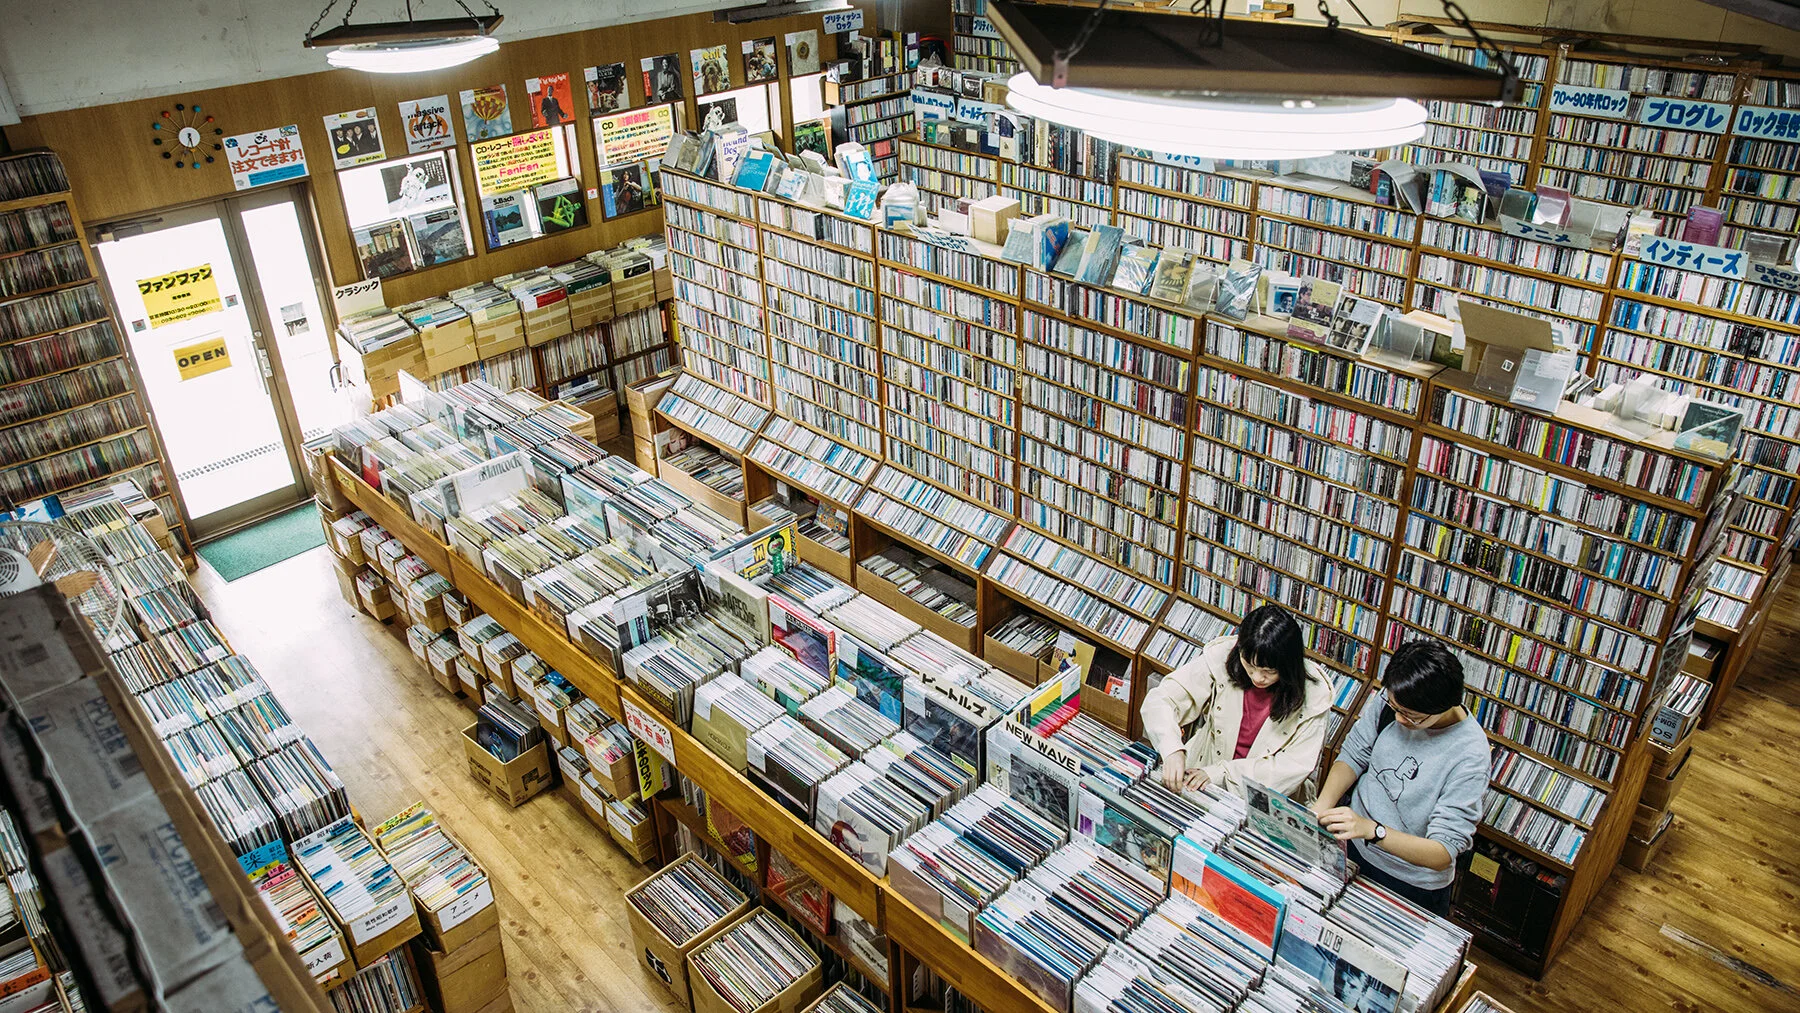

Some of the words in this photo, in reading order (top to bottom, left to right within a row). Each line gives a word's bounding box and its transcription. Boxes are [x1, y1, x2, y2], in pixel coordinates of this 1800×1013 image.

[825, 13, 861, 24] ブリティッシュ
[836, 21, 852, 30] ロック
[974, 20, 996, 32] ブリティッ
[413, 120, 442, 131] attack
[602, 121, 613, 130] CD
[1648, 102, 1723, 128] プログレ
[238, 137, 290, 158] レコード針
[231, 149, 304, 175] 注文できます!
[499, 162, 539, 177] FanFan
[1516, 222, 1571, 243] アニメ
[1646, 239, 1742, 275] インディーズ
[138, 268, 212, 295] ファンファン
[336, 281, 379, 299] クラシック
[178, 347, 226, 368] OPEN
[922, 673, 987, 718] ビートルズ
[1006, 721, 1033, 745] NEW
[1038, 740, 1077, 771] WAVE
[451, 892, 479, 913] アニメ
